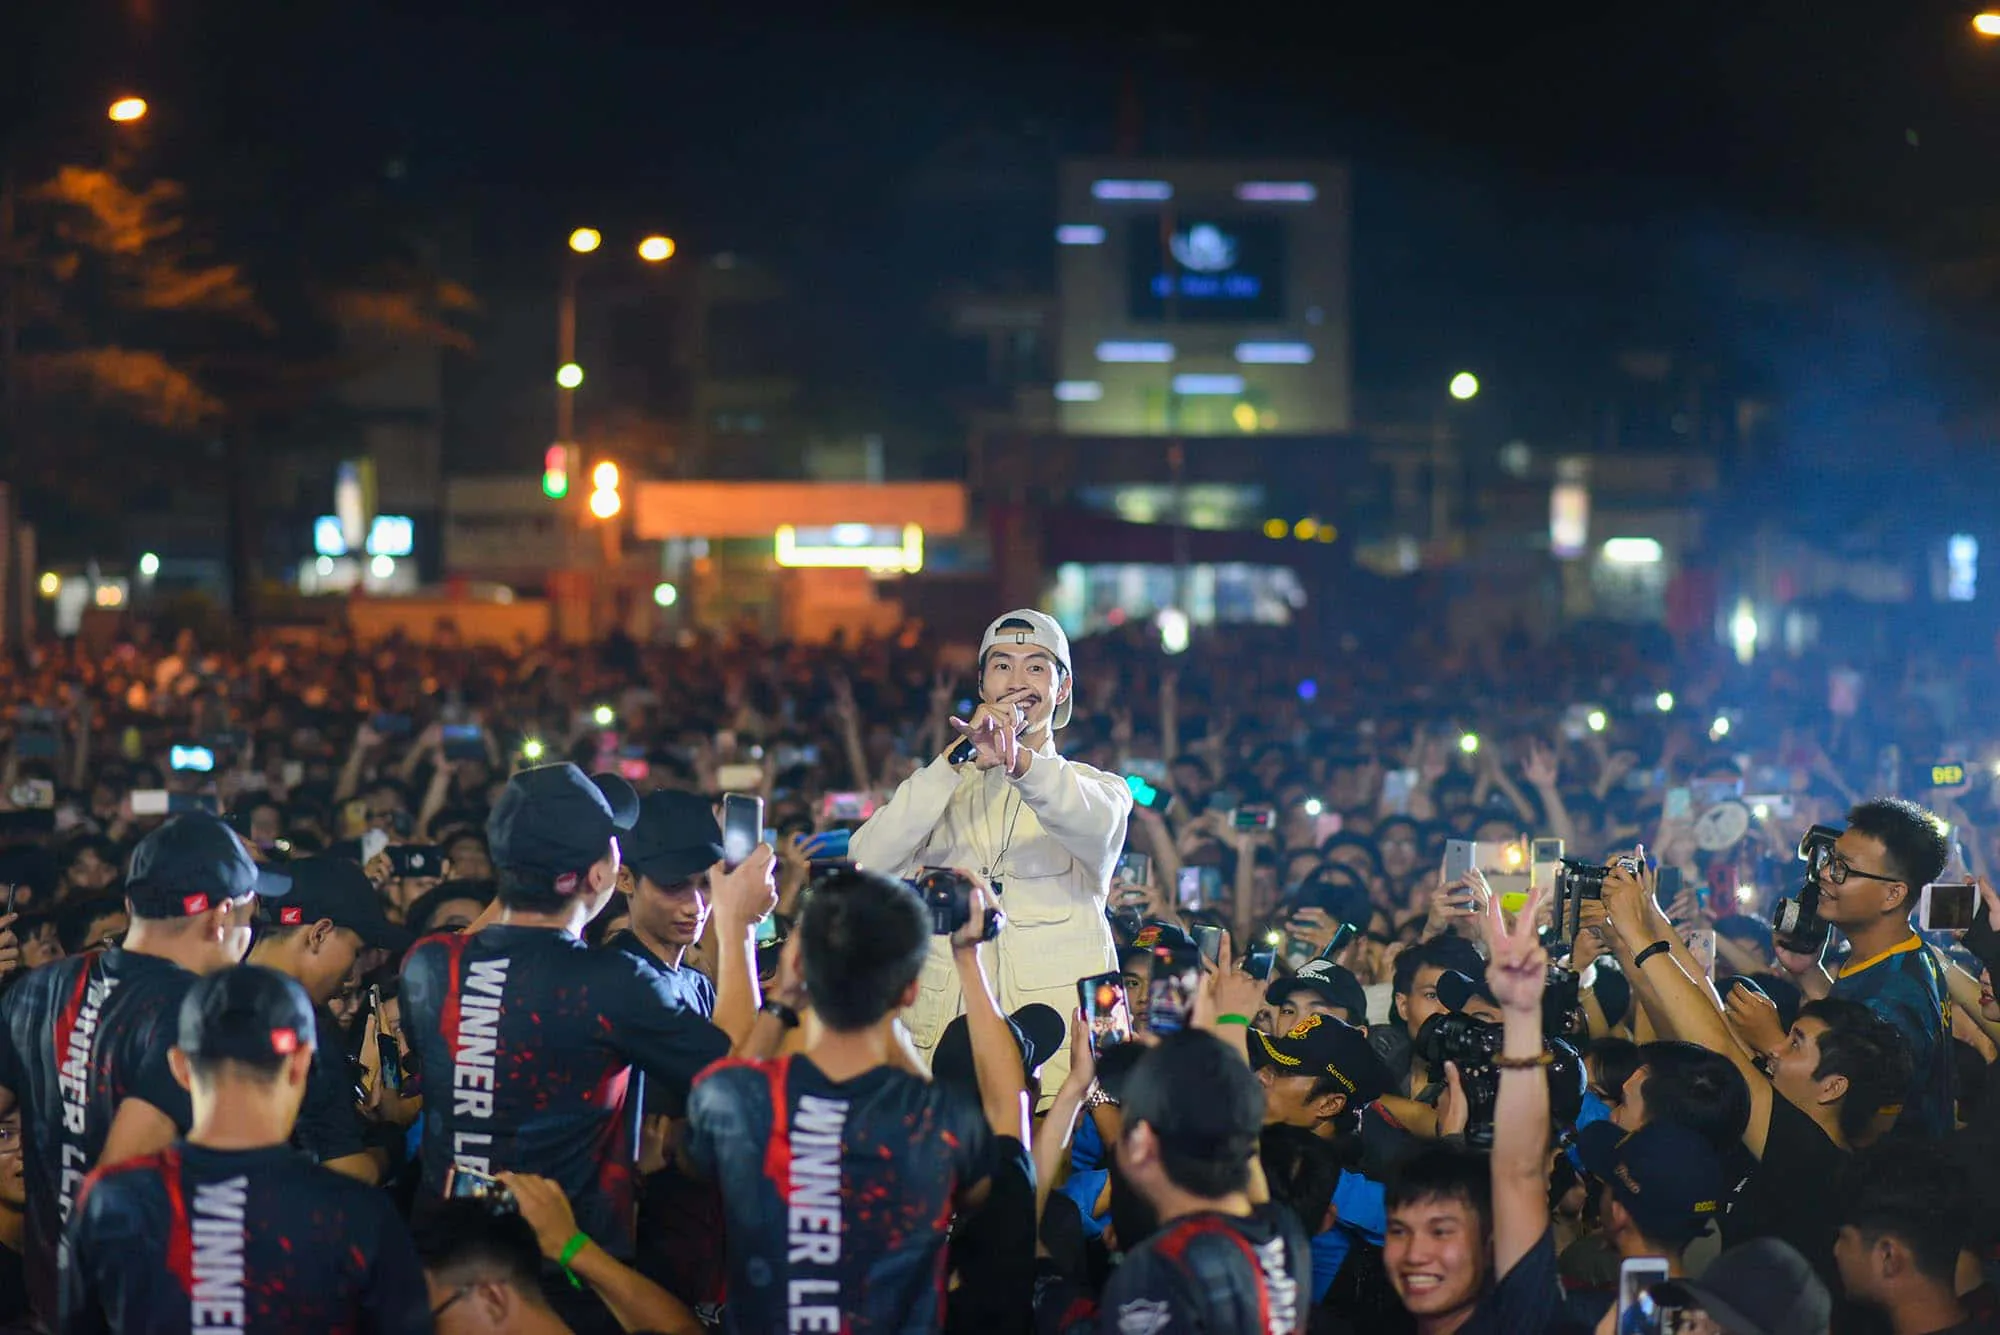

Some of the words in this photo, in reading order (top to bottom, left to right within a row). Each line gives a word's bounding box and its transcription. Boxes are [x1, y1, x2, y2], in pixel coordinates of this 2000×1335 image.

[58, 976, 121, 1135] WINNER
[454, 957, 511, 1119] WINNER
[1326, 1063, 1357, 1093] Security
[788, 1094, 850, 1265] WINNER
[788, 1279, 841, 1335] LE
